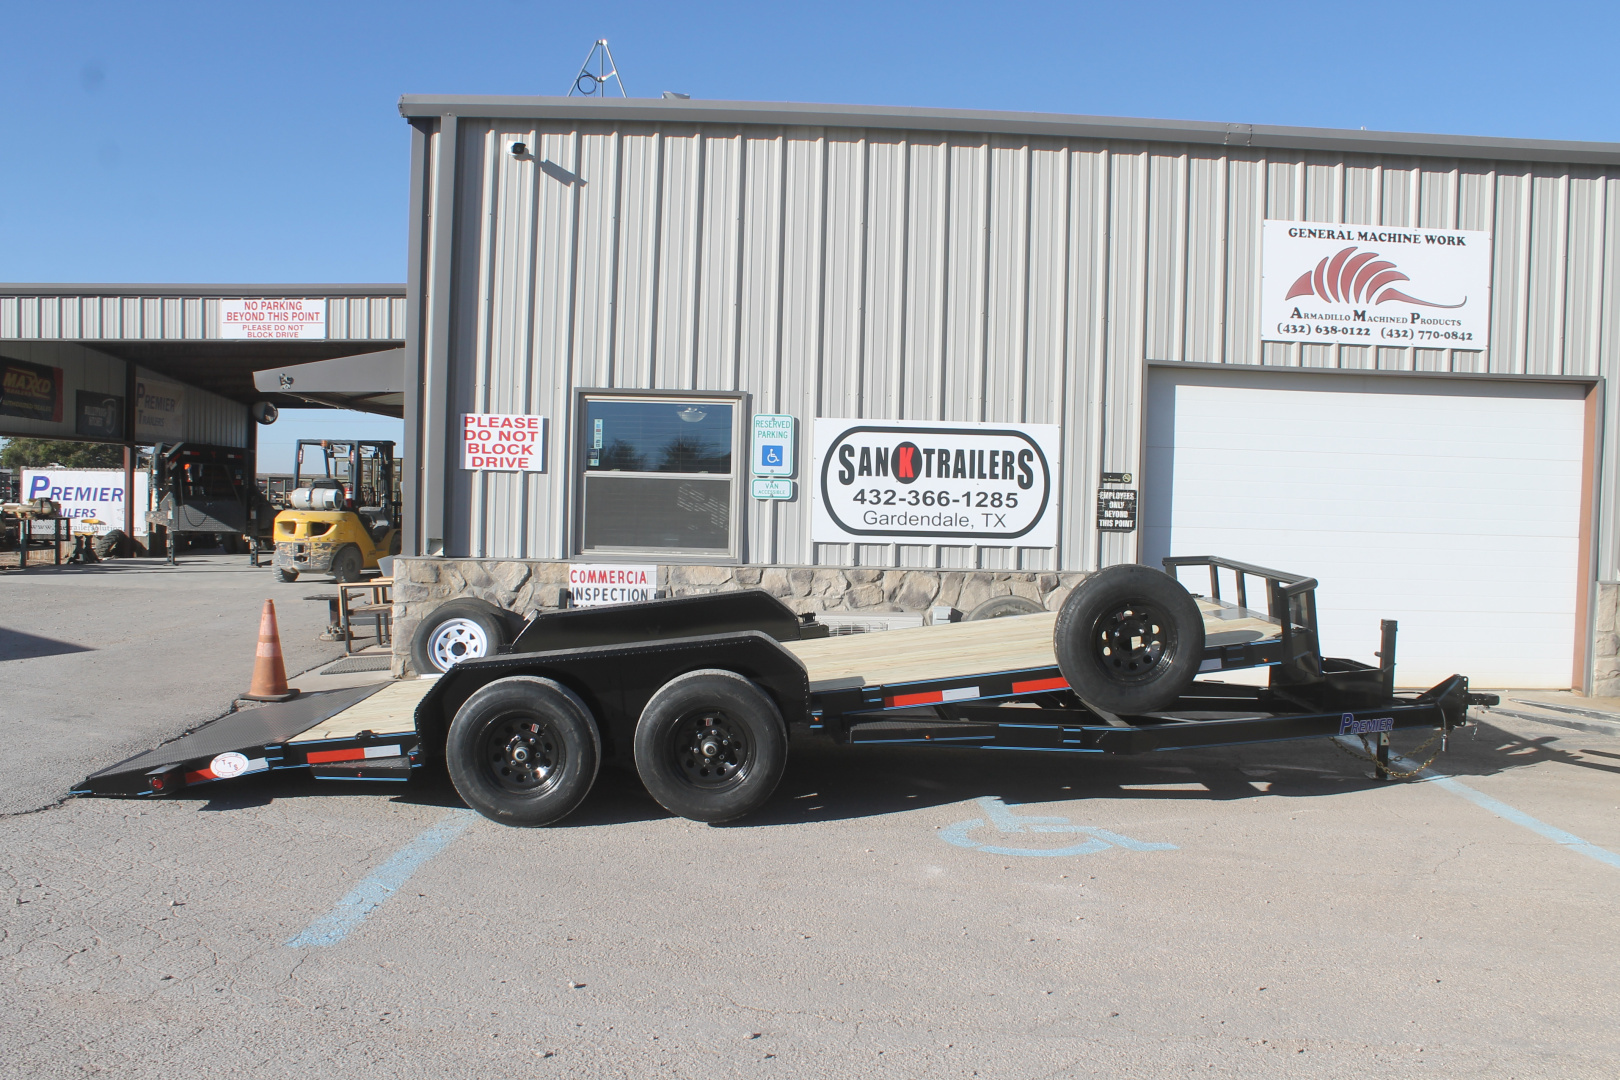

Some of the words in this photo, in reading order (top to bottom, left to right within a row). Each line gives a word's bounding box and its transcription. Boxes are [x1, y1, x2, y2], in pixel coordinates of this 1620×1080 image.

[1288, 227, 1354, 241] GENERAL
[1357, 231, 1421, 244] MACHINE
[1424, 234, 1466, 246] WORK
[244, 301, 258, 310] NO
[261, 301, 303, 310] PARKING
[226, 312, 265, 321] BEYOND
[268, 312, 289, 321] THIS
[292, 312, 320, 321] POINT
[1290, 306, 1351, 321] ARMADILLO
[1352, 309, 1408, 324] MACHINED
[1410, 312, 1462, 327] PRODUCTS
[1277, 322, 1311, 336] (432)
[1314, 324, 1370, 337] 638-0122
[1380, 327, 1414, 340] (432)
[1418, 330, 1473, 341] 770-0842
[136, 383, 175, 413] PREMIER
[464, 416, 539, 429] PLEASE
[755, 420, 791, 429] RESERVED
[464, 429, 492, 441] DO
[498, 430, 539, 442] NOT
[757, 430, 788, 439] PARKING
[467, 443, 534, 455] BLOCK
[471, 456, 529, 469] DRIVE
[29, 475, 124, 502] PREMIER
[852, 489, 1018, 508] 432-366-1285
[1099, 491, 1135, 500] EMPLOYEES
[1109, 501, 1125, 509] ONLY
[863, 510, 974, 529] Gardendale,
[981, 512, 1007, 528] TX
[1099, 519, 1114, 527] THIS
[1114, 519, 1133, 527] POINT
[570, 570, 647, 584] COMMERCIA
[572, 587, 648, 602] INSPECTION
[1338, 712, 1394, 735] PREMIER
